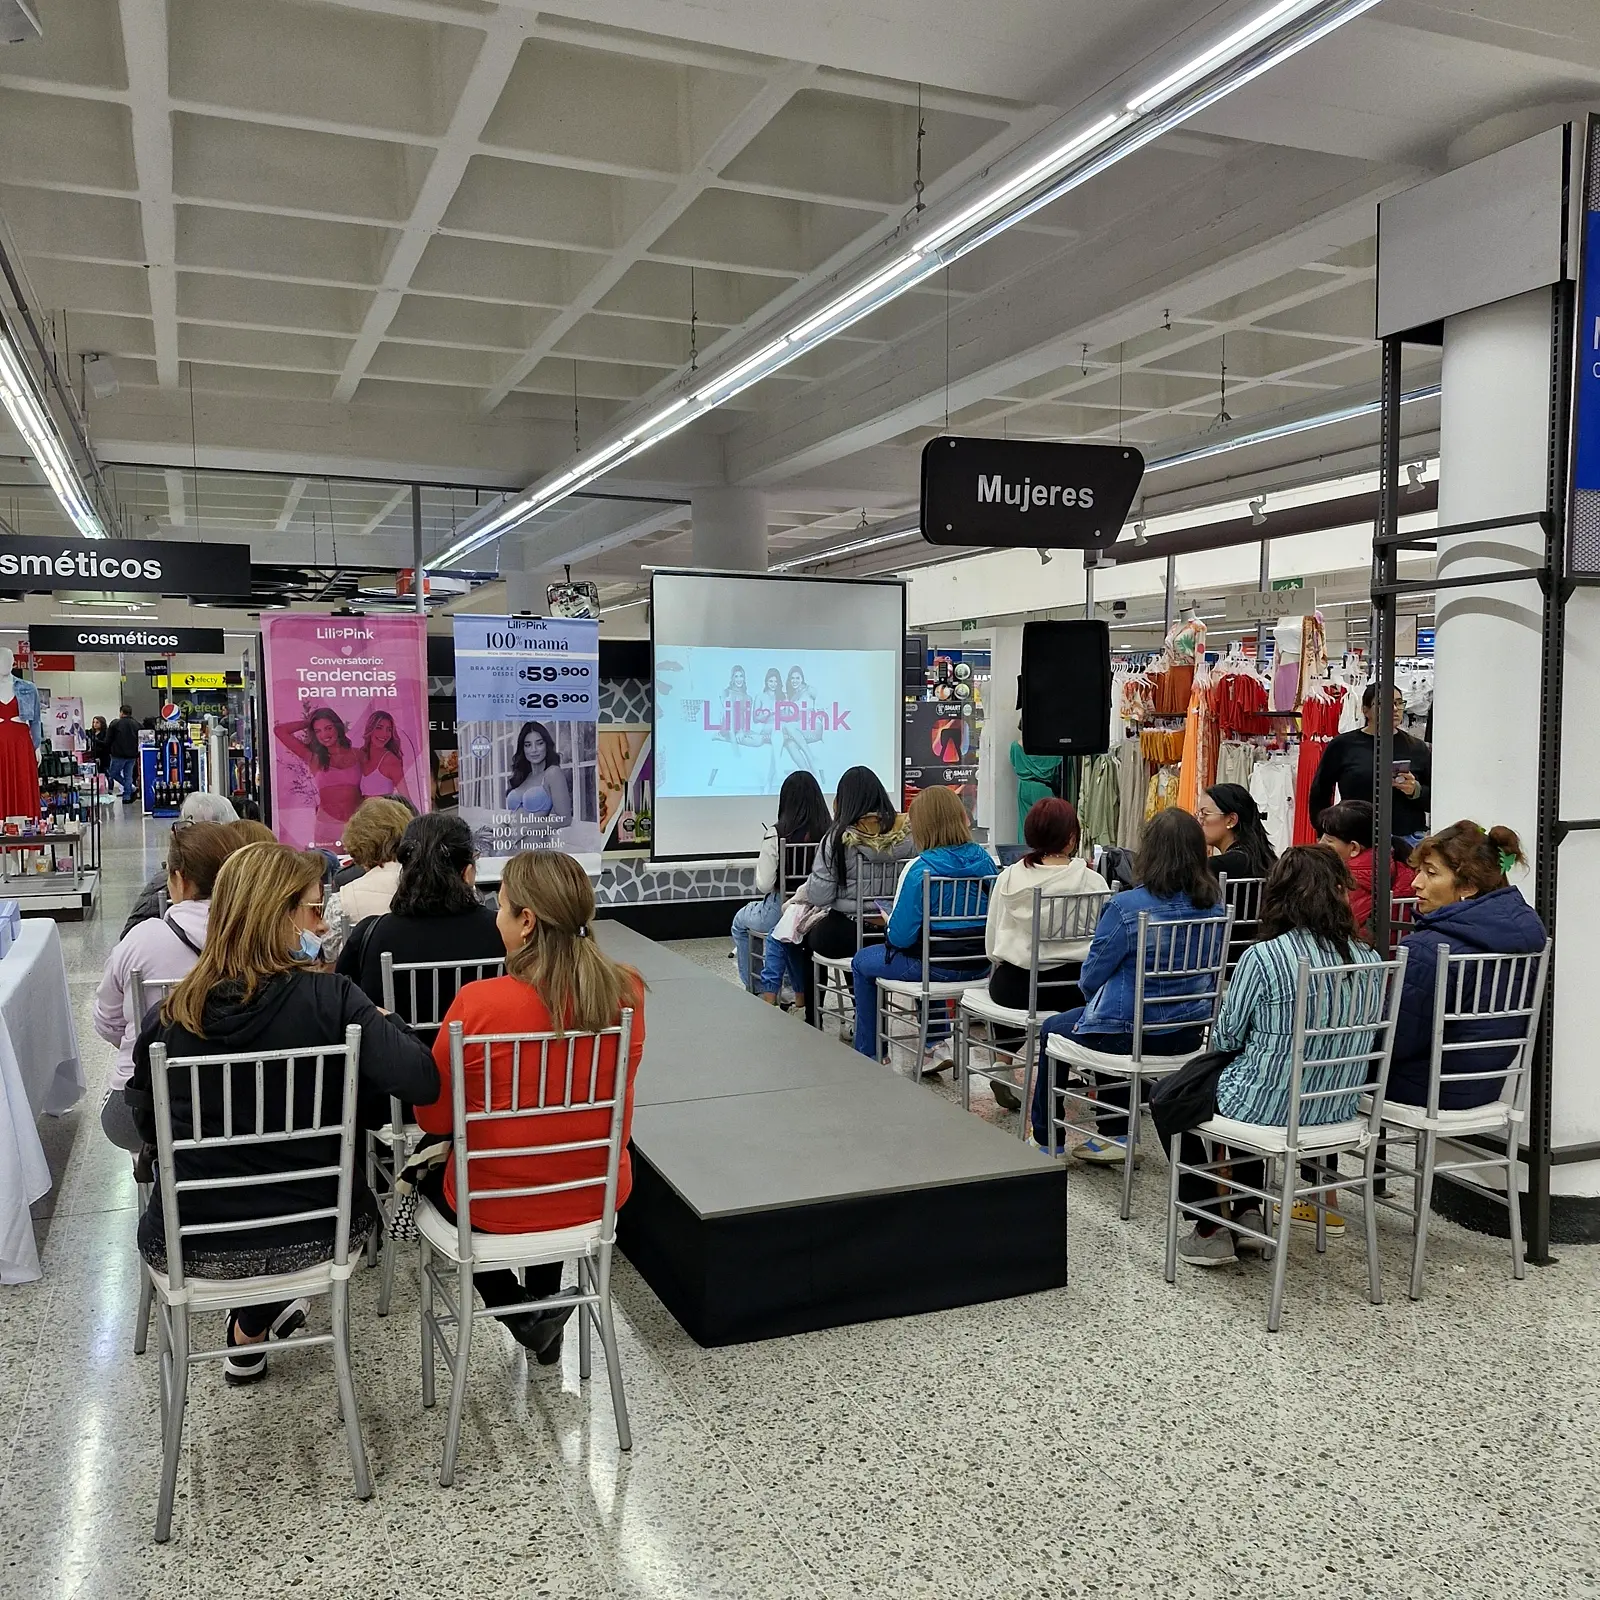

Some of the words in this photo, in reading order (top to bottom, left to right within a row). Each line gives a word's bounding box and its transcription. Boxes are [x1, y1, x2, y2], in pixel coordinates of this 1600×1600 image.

[977, 474, 1094, 512] Mujeres
[0, 550, 162, 580] sméticos
[77, 630, 179, 646] cosméticos
[343, 627, 375, 640] Pink
[486, 632, 523, 649] 100%
[524, 637, 569, 651] mamá
[12, 660, 39, 669] Clao
[310, 656, 384, 665] Conversatorio:
[195, 676, 218, 684] efecty
[296, 667, 396, 682] Tendencias
[518, 666, 589, 682] $59.900
[297, 686, 337, 701] para
[341, 683, 398, 698] mamá
[194, 702, 224, 712] efect
[518, 693, 589, 709] $26.900
[774, 700, 852, 731] Pink
[492, 814, 517, 825] 100%
[520, 812, 566, 824] Influencer
[492, 827, 517, 838] 100%
[520, 839, 565, 851] Imparable
